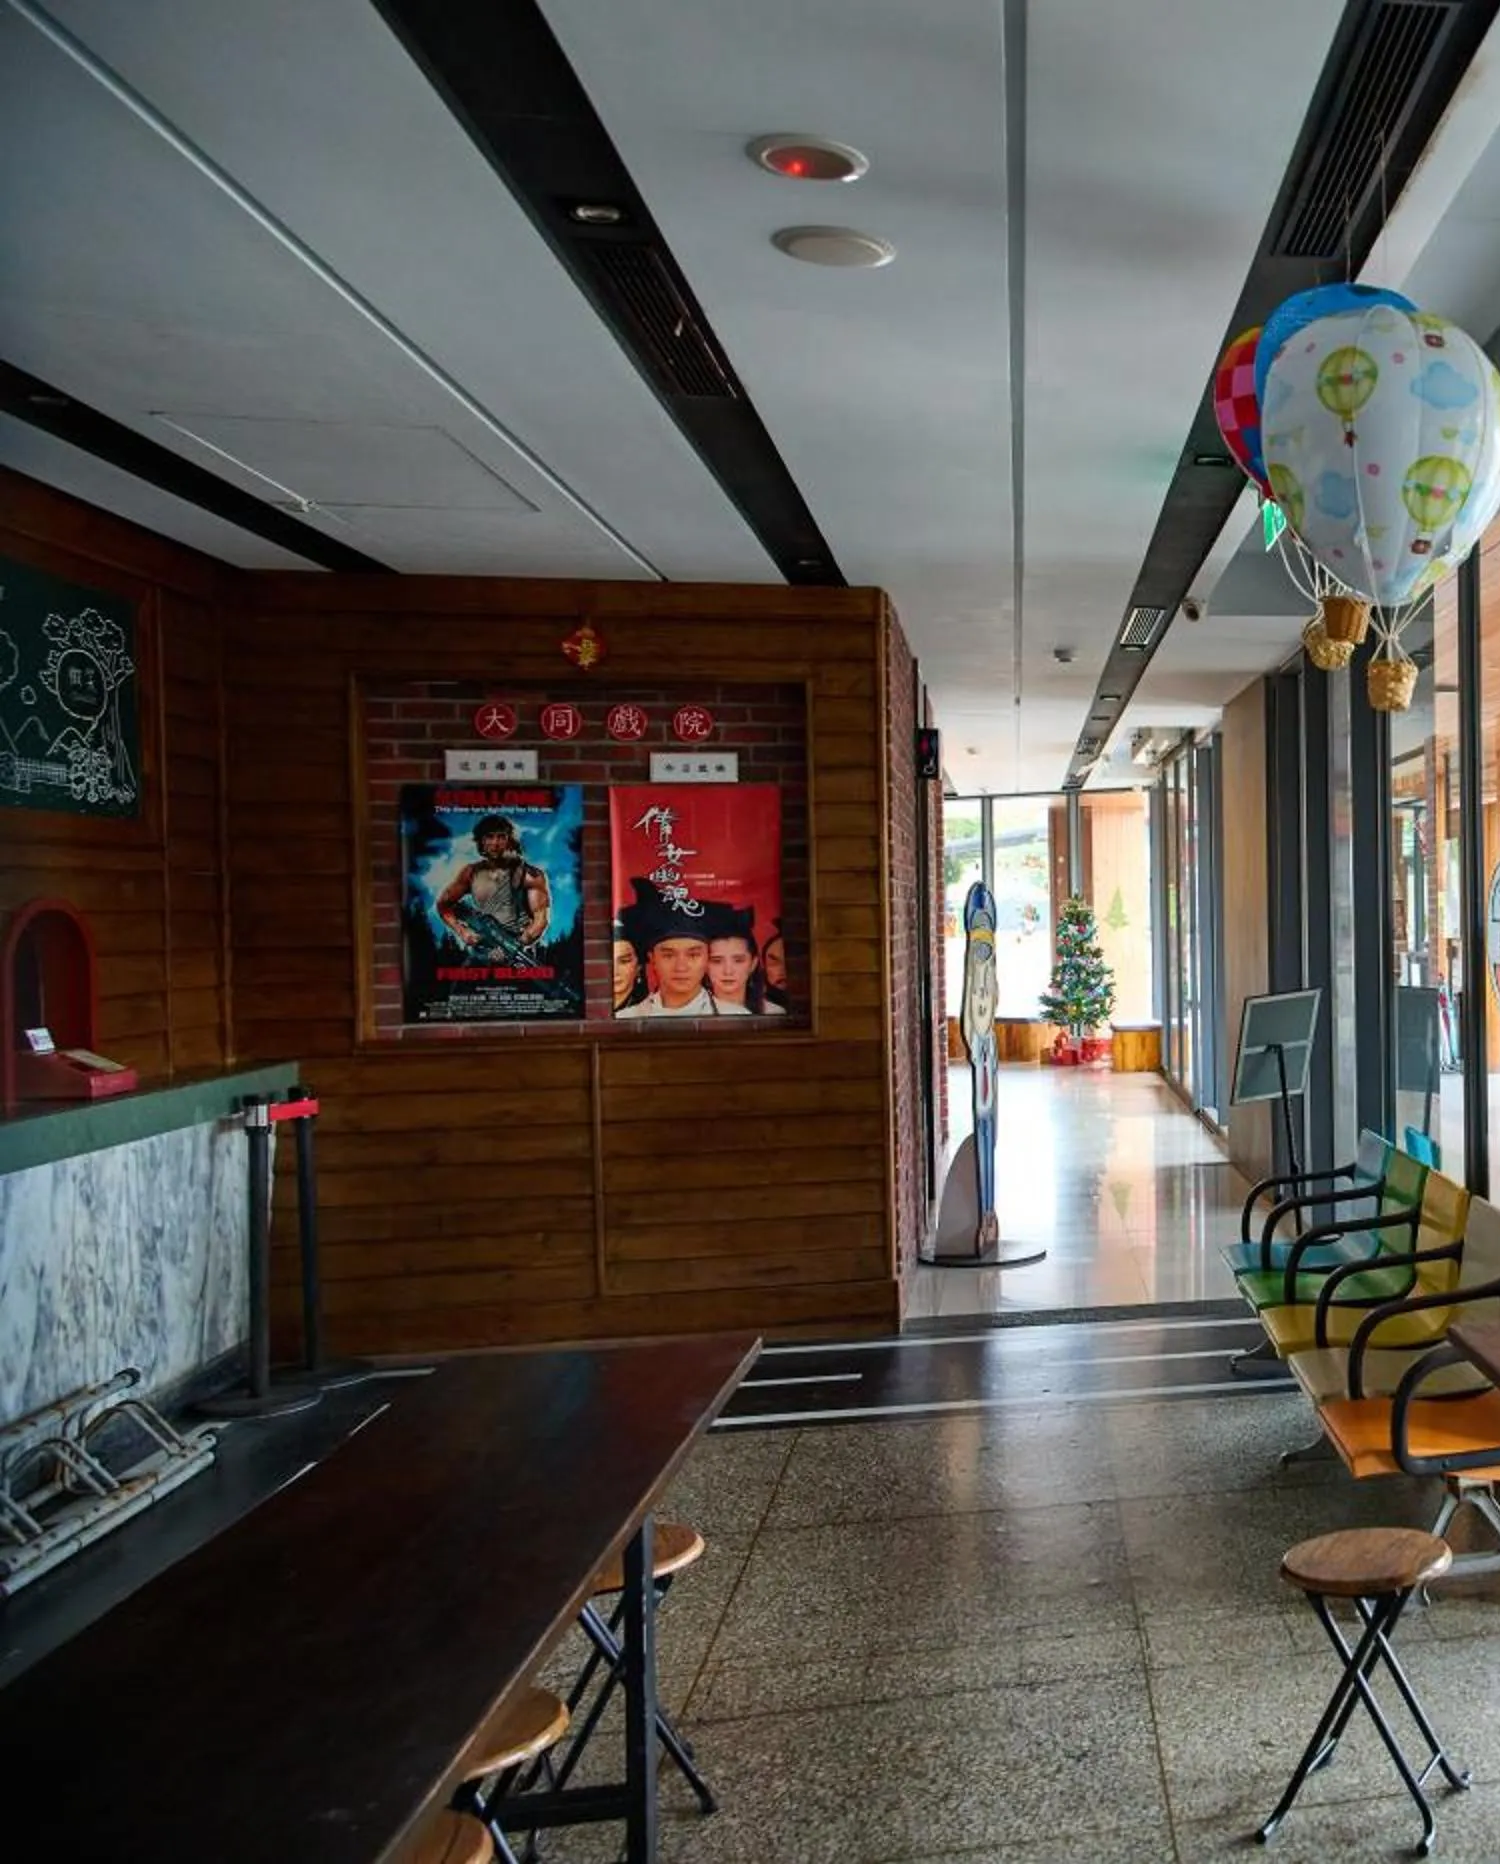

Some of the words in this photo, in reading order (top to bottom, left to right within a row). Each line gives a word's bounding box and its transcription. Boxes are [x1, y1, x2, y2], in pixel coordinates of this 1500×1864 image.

[483, 703, 709, 736] 大同戲院
[633, 806, 705, 917] 倩女幽魂
[436, 966, 488, 981] FIRST
